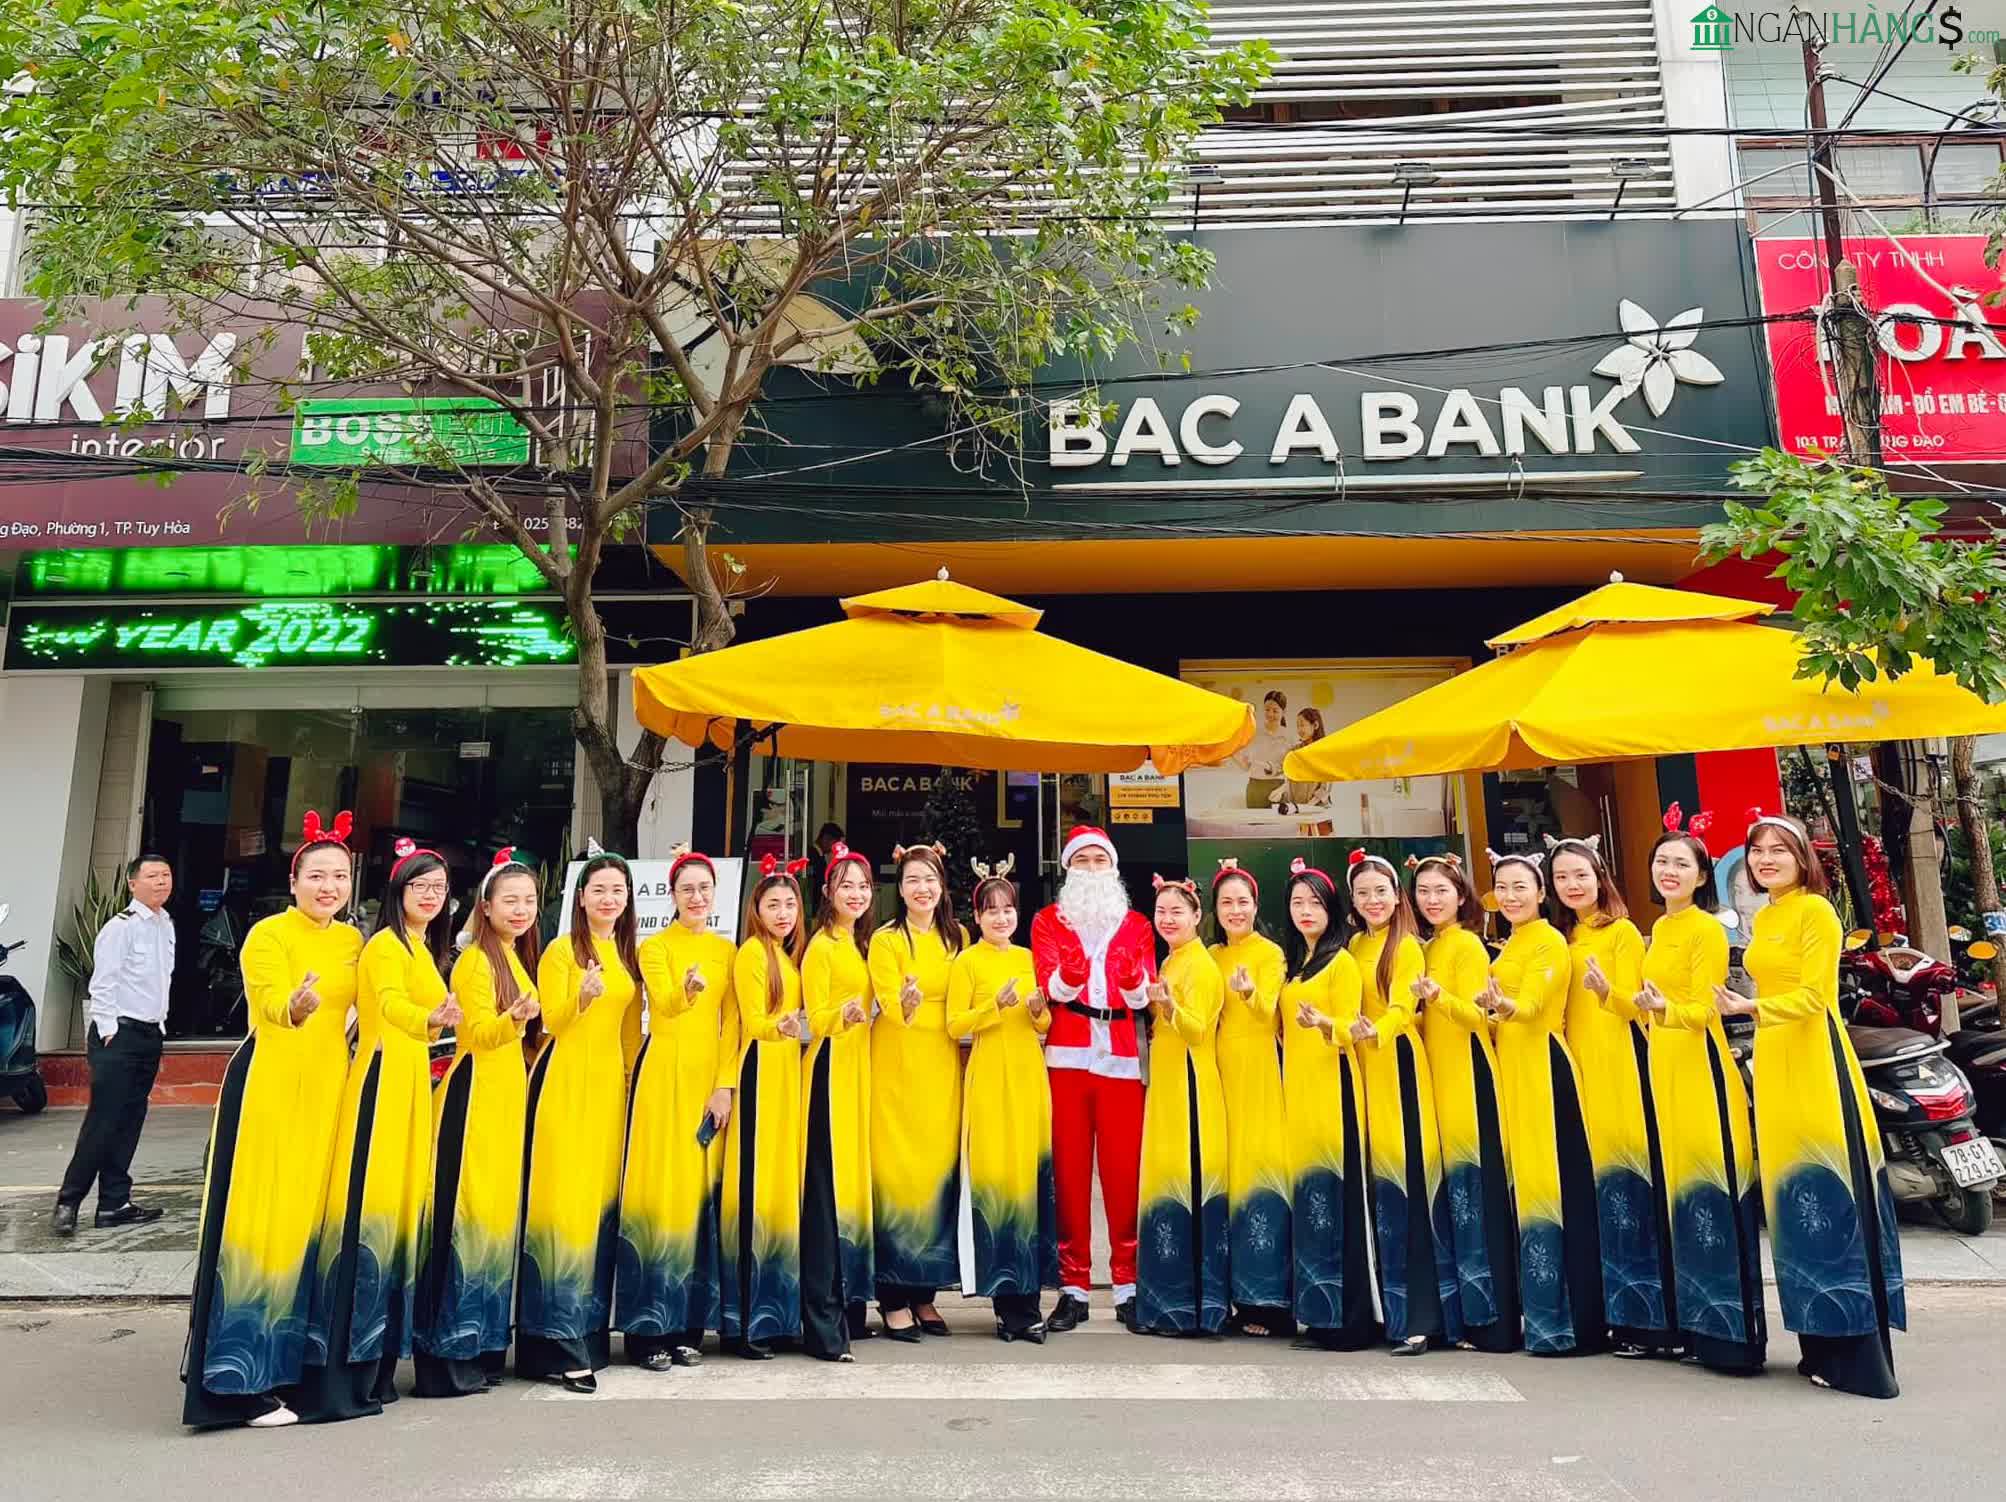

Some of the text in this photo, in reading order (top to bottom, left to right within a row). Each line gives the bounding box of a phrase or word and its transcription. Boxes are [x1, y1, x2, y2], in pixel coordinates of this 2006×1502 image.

[1854, 252, 1881, 268] TY
[1888, 249, 1945, 267] TNHH
[0, 333, 238, 423] iKIM
[1048, 384, 1641, 467] BAC A BANK
[70, 433, 225, 460] interior
[46, 521, 97, 538] Phường
[136, 521, 160, 537] Tuy
[523, 517, 550, 531] 025
[113, 618, 239, 653] YEAR
[246, 617, 370, 654] 2022
[860, 776, 900, 792] BAC
[903, 776, 917, 792] A
